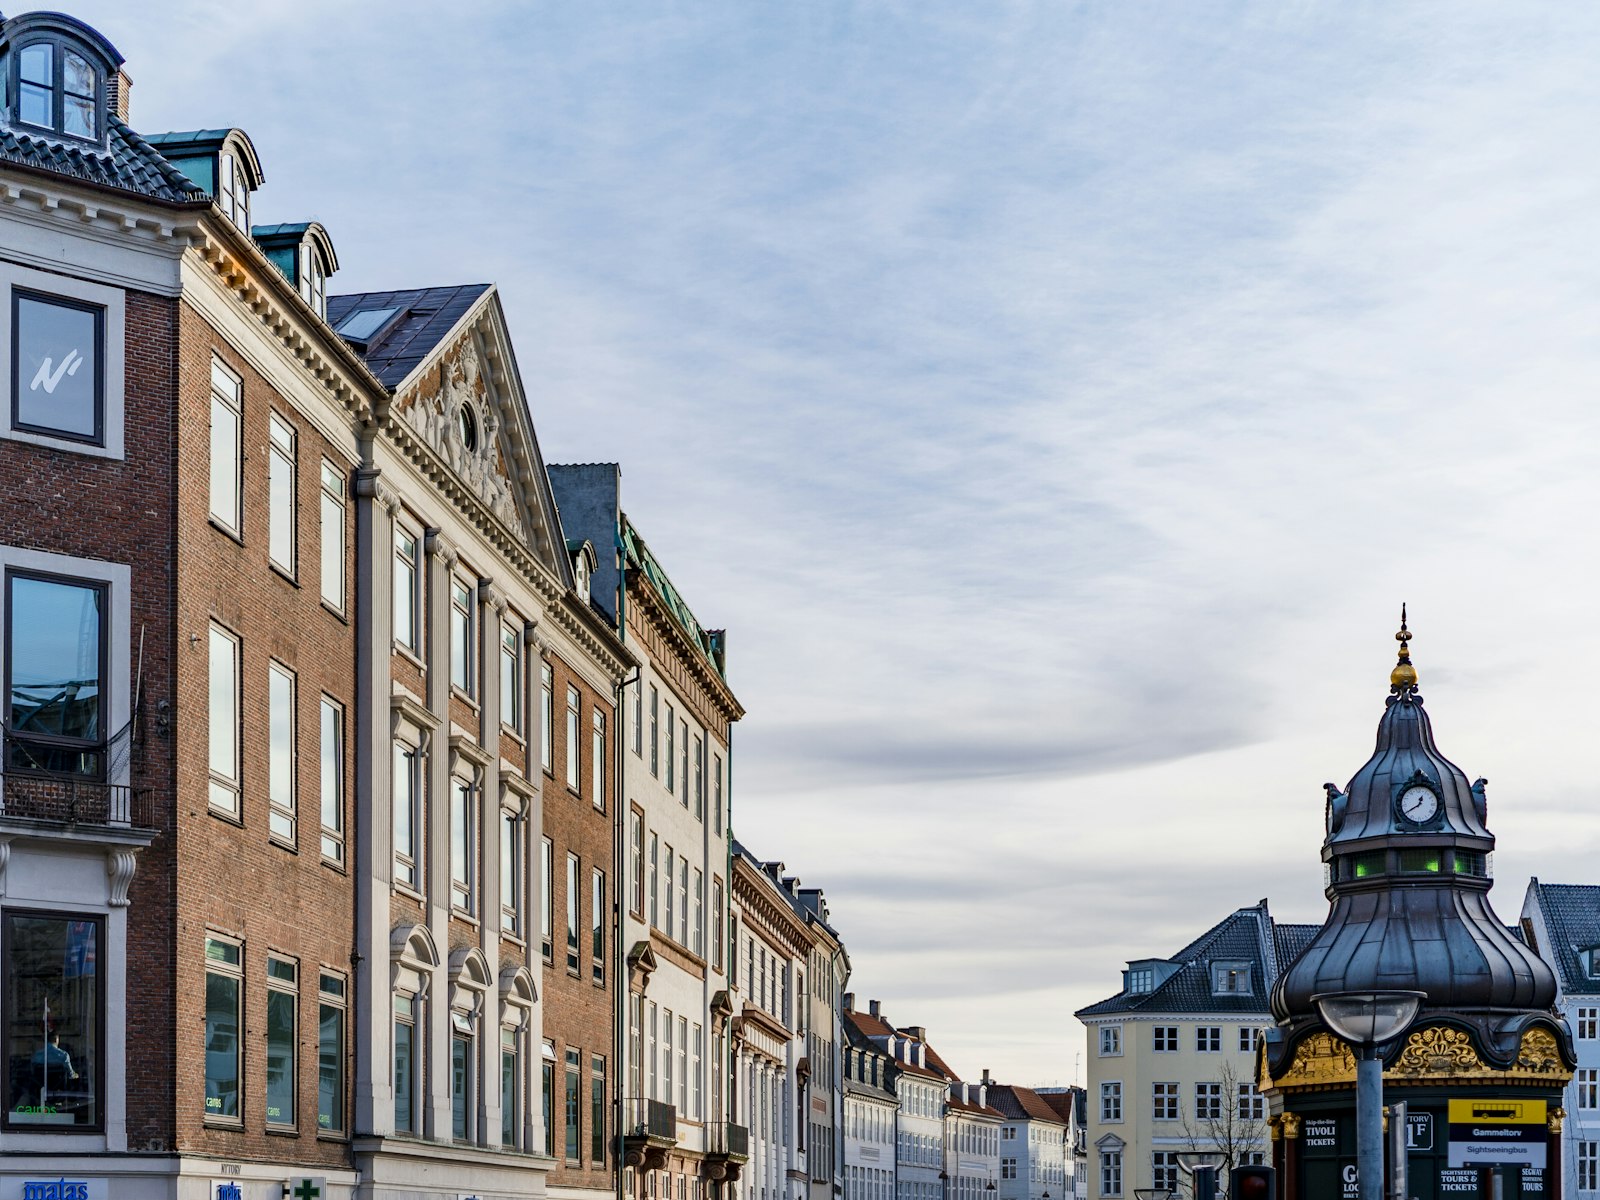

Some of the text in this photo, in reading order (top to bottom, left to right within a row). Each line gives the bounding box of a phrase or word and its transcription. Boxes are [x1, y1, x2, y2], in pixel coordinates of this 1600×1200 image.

[16, 1105, 57, 1115] cairos
[1306, 1127, 1336, 1136] TIVOLI
[1472, 1128, 1522, 1137] Gammeltorv
[1306, 1138, 1336, 1146] TICKETS
[1467, 1146, 1527, 1154] Sightseeingbus
[1342, 1165, 1359, 1183] G
[23, 1177, 89, 1200] matas
[1522, 1183, 1543, 1192] TOURS
